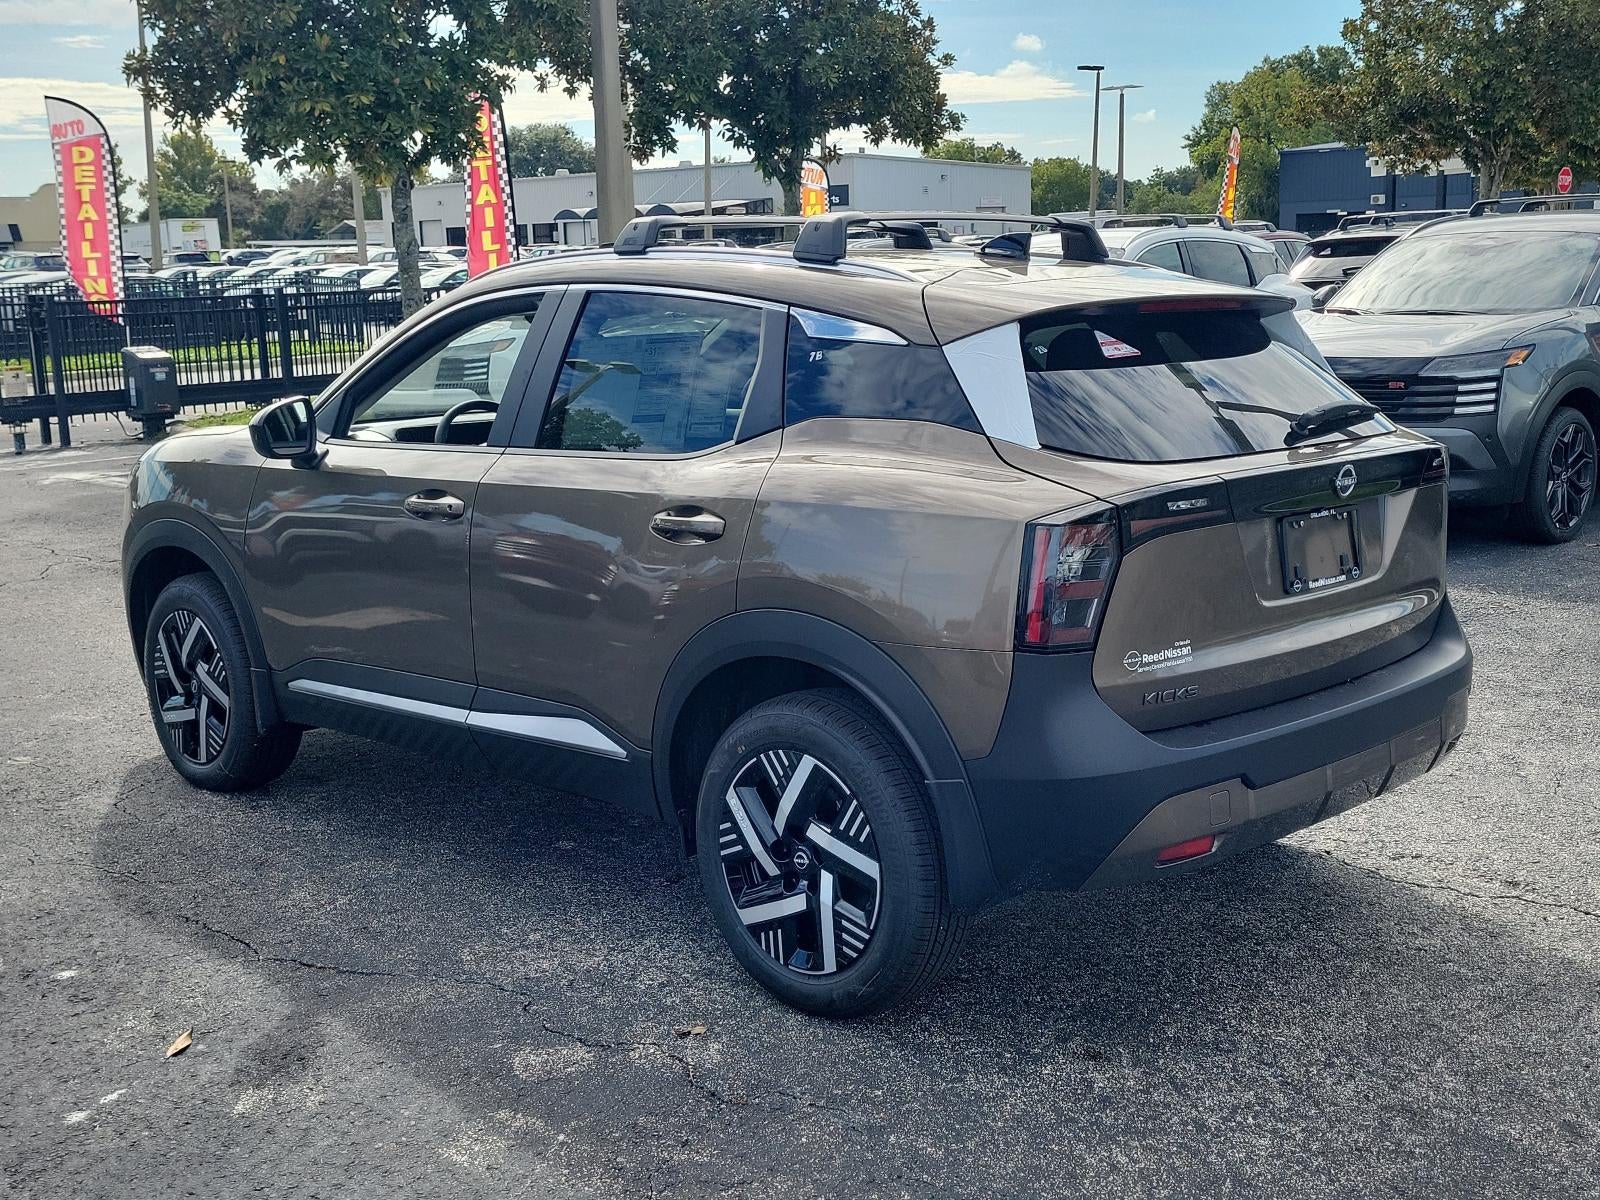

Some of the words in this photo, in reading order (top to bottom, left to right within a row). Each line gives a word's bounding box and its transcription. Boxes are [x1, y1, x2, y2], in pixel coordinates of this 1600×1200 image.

[51, 119, 85, 140] AUTO
[1559, 176, 1572, 186] STOP
[1336, 478, 1357, 487] NISSAN
[1142, 685, 1199, 706] KICKS
